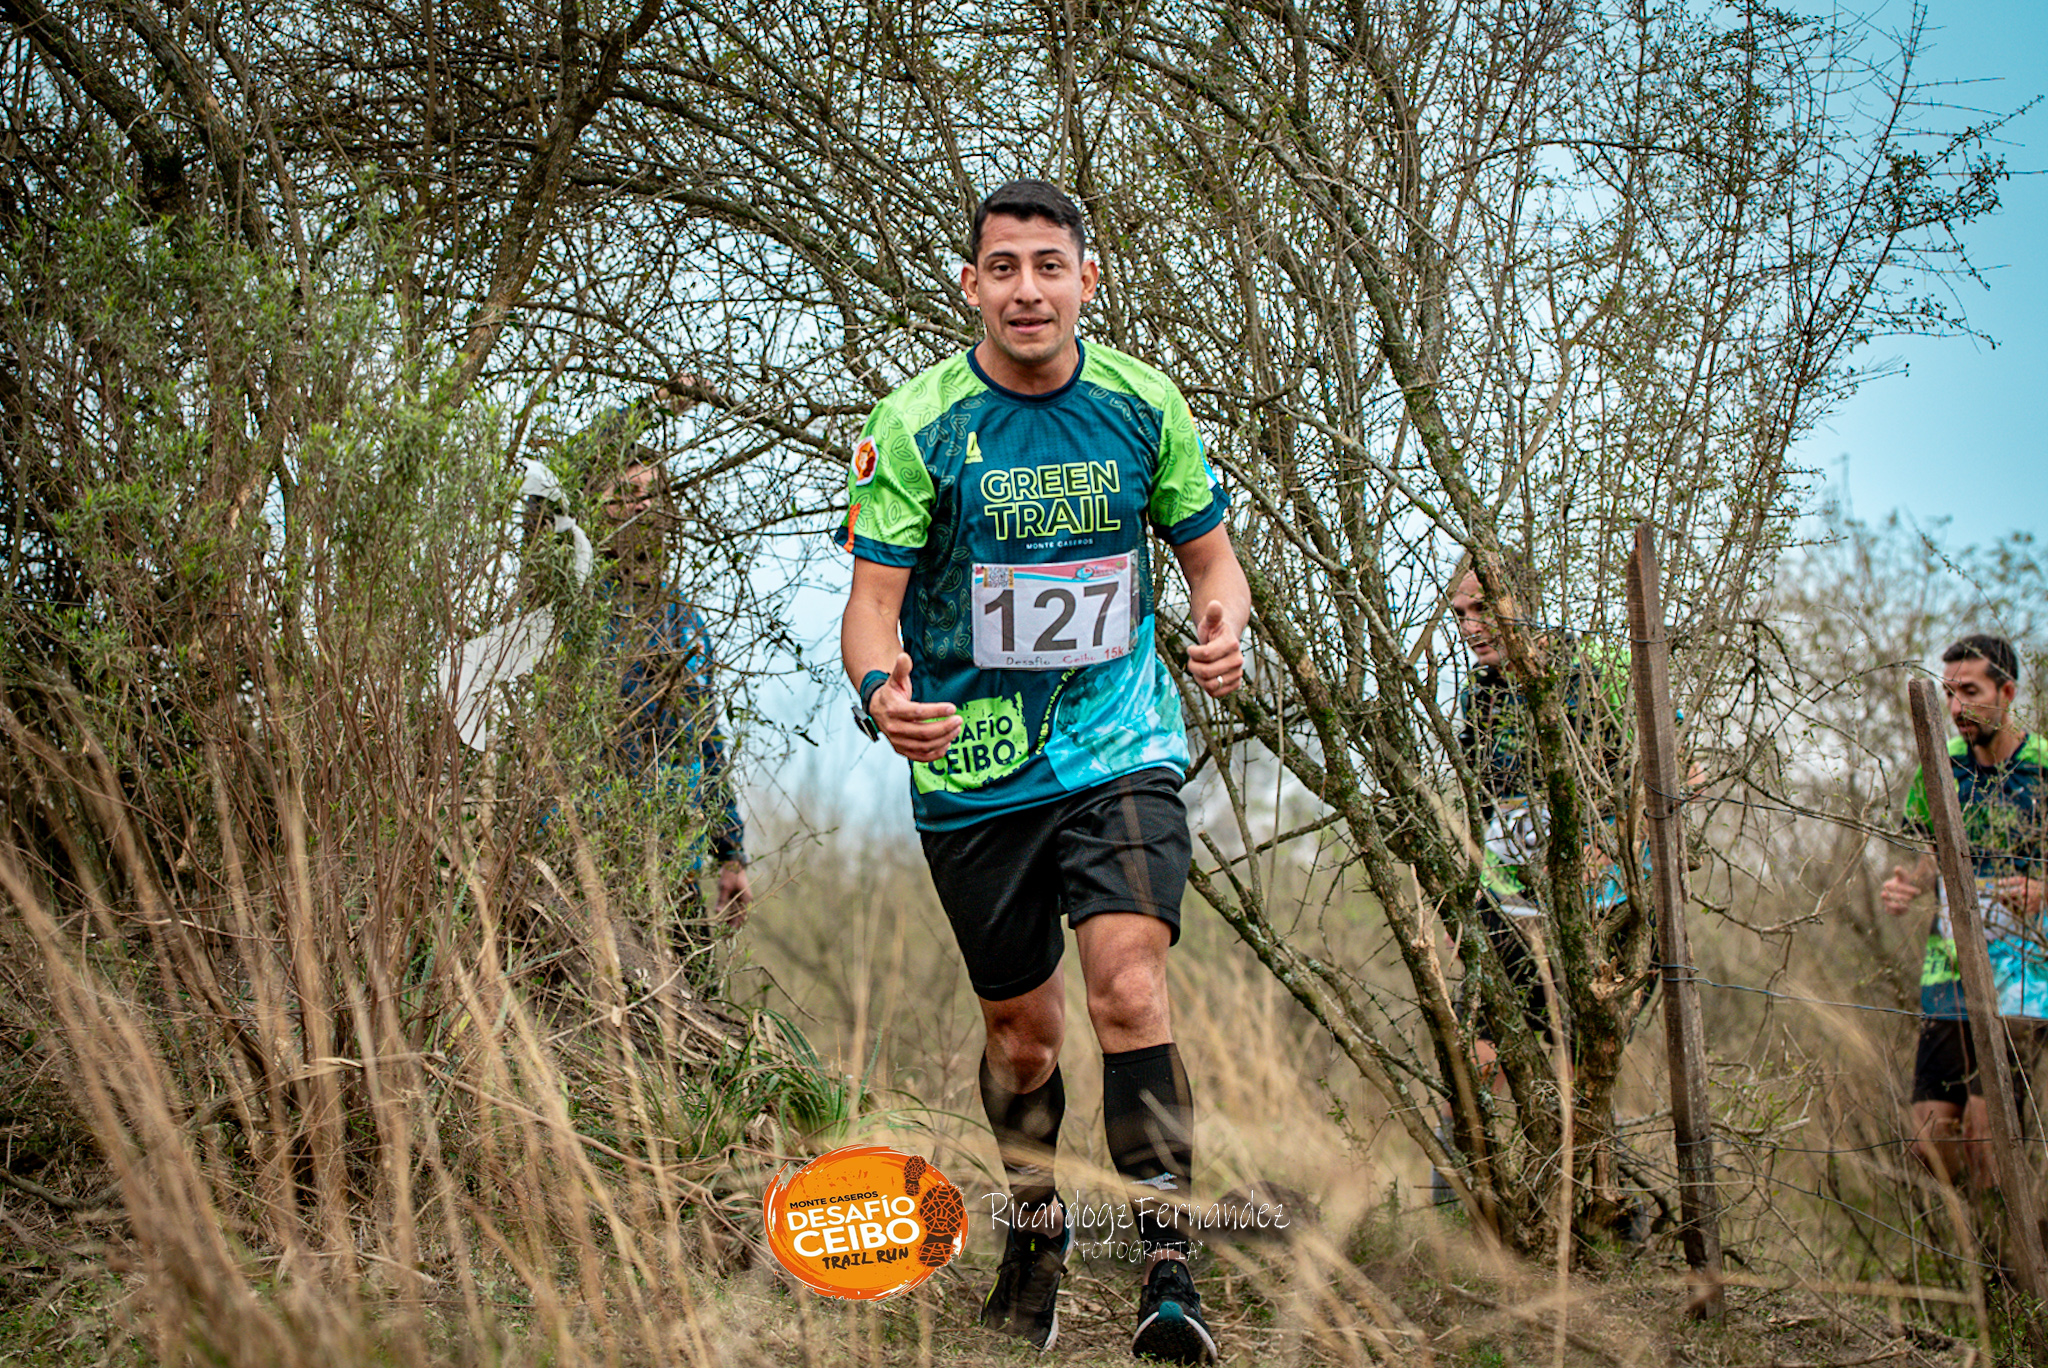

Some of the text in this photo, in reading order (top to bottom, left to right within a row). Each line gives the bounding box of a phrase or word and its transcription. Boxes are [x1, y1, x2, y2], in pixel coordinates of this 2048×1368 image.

[980, 460, 1121, 503] GREEN
[984, 494, 1121, 541] TRAIL
[1026, 541, 1055, 550] MONTE
[984, 581, 1120, 652] 127
[951, 712, 1013, 745] AFÍO
